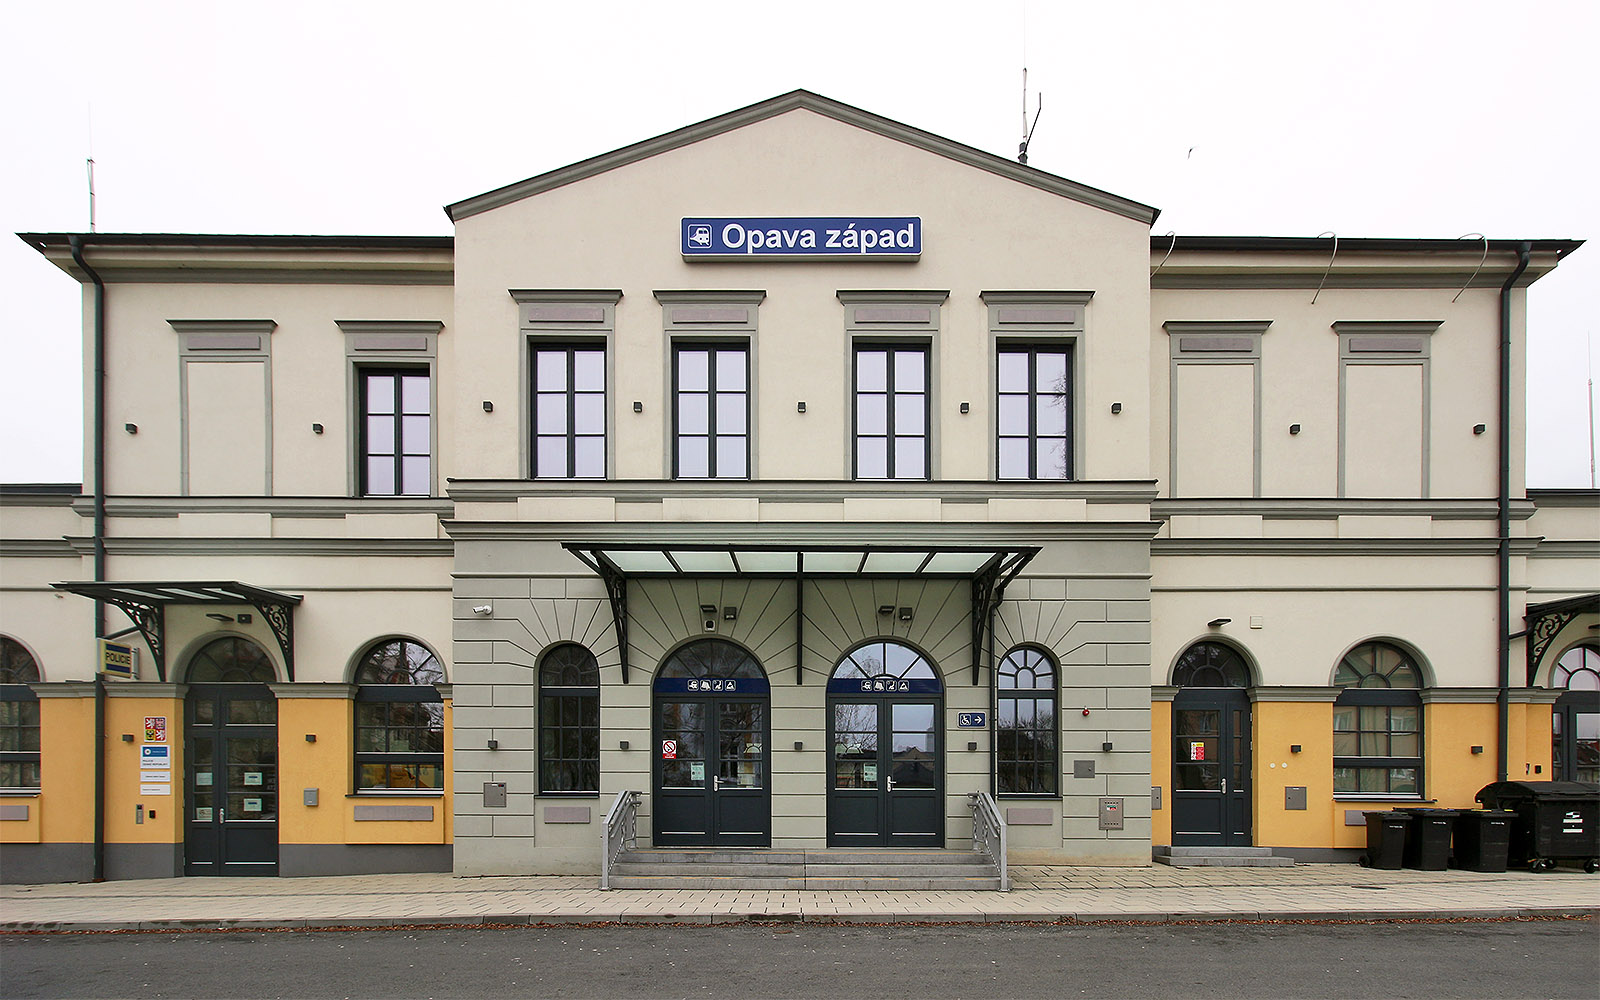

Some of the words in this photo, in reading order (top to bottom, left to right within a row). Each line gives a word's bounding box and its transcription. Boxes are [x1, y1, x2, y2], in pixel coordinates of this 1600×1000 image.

[722, 223, 816, 254] Opava
[825, 223, 914, 254] západ
[105, 651, 131, 664] POLICIE
